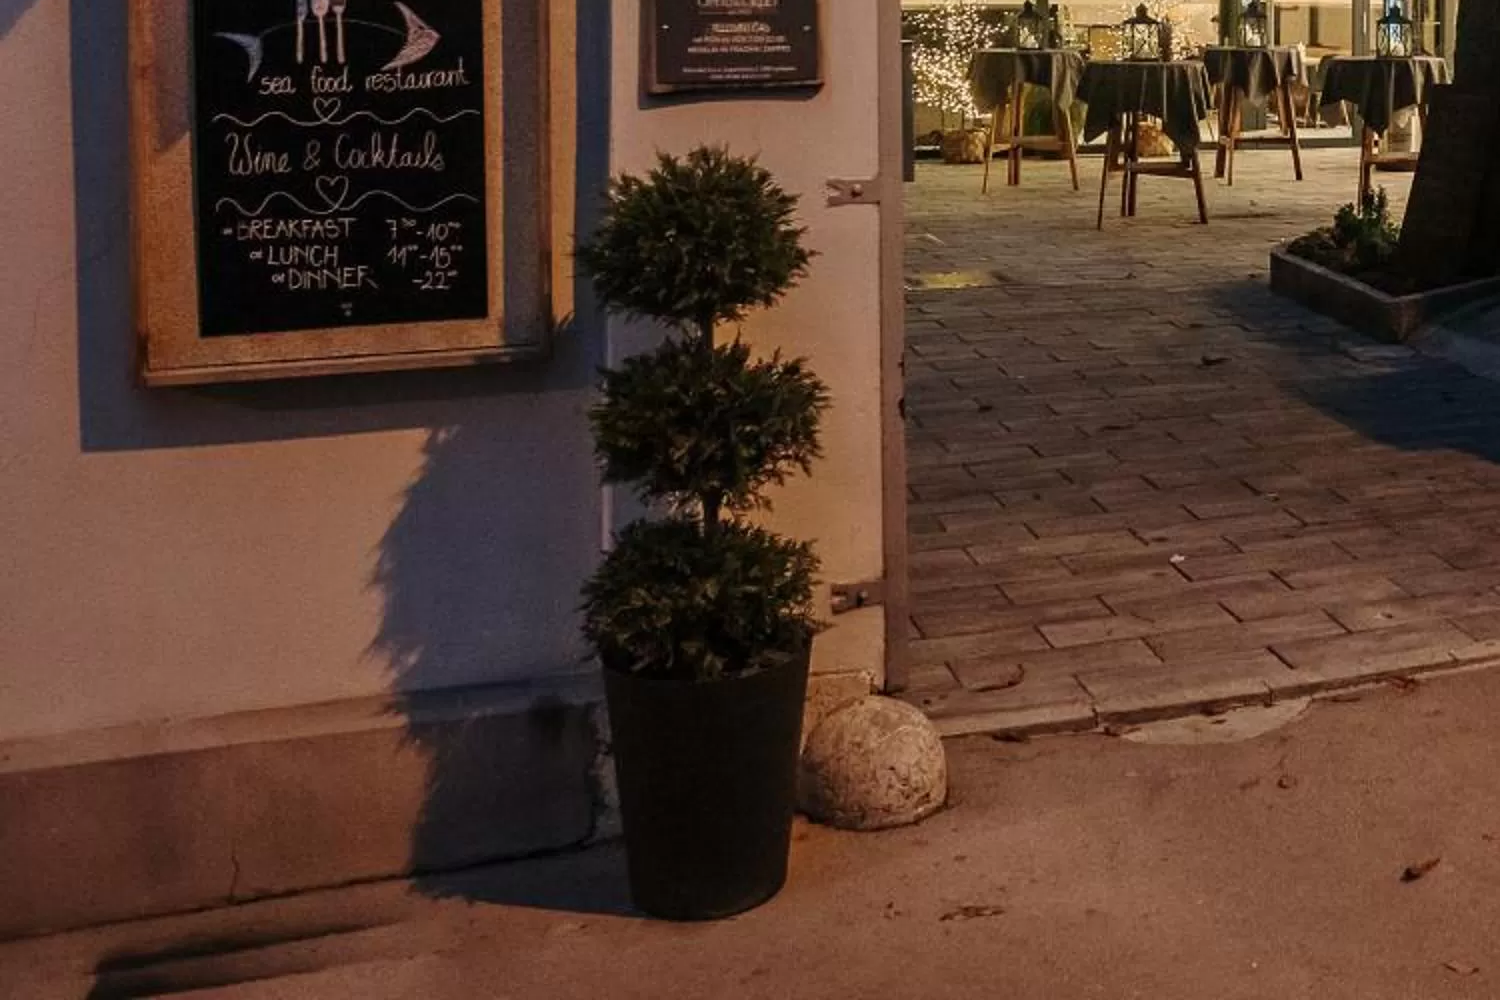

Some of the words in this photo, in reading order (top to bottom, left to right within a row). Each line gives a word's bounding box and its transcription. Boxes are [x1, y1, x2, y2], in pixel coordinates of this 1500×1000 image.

[258, 73, 297, 95] sea
[310, 65, 353, 93] food
[365, 55, 471, 92] restaurant
[224, 131, 293, 176] Wine
[302, 139, 322, 171] &
[334, 130, 446, 171] Cocktails
[236, 217, 358, 241] BREAKFAST
[267, 244, 340, 268] LUNCH
